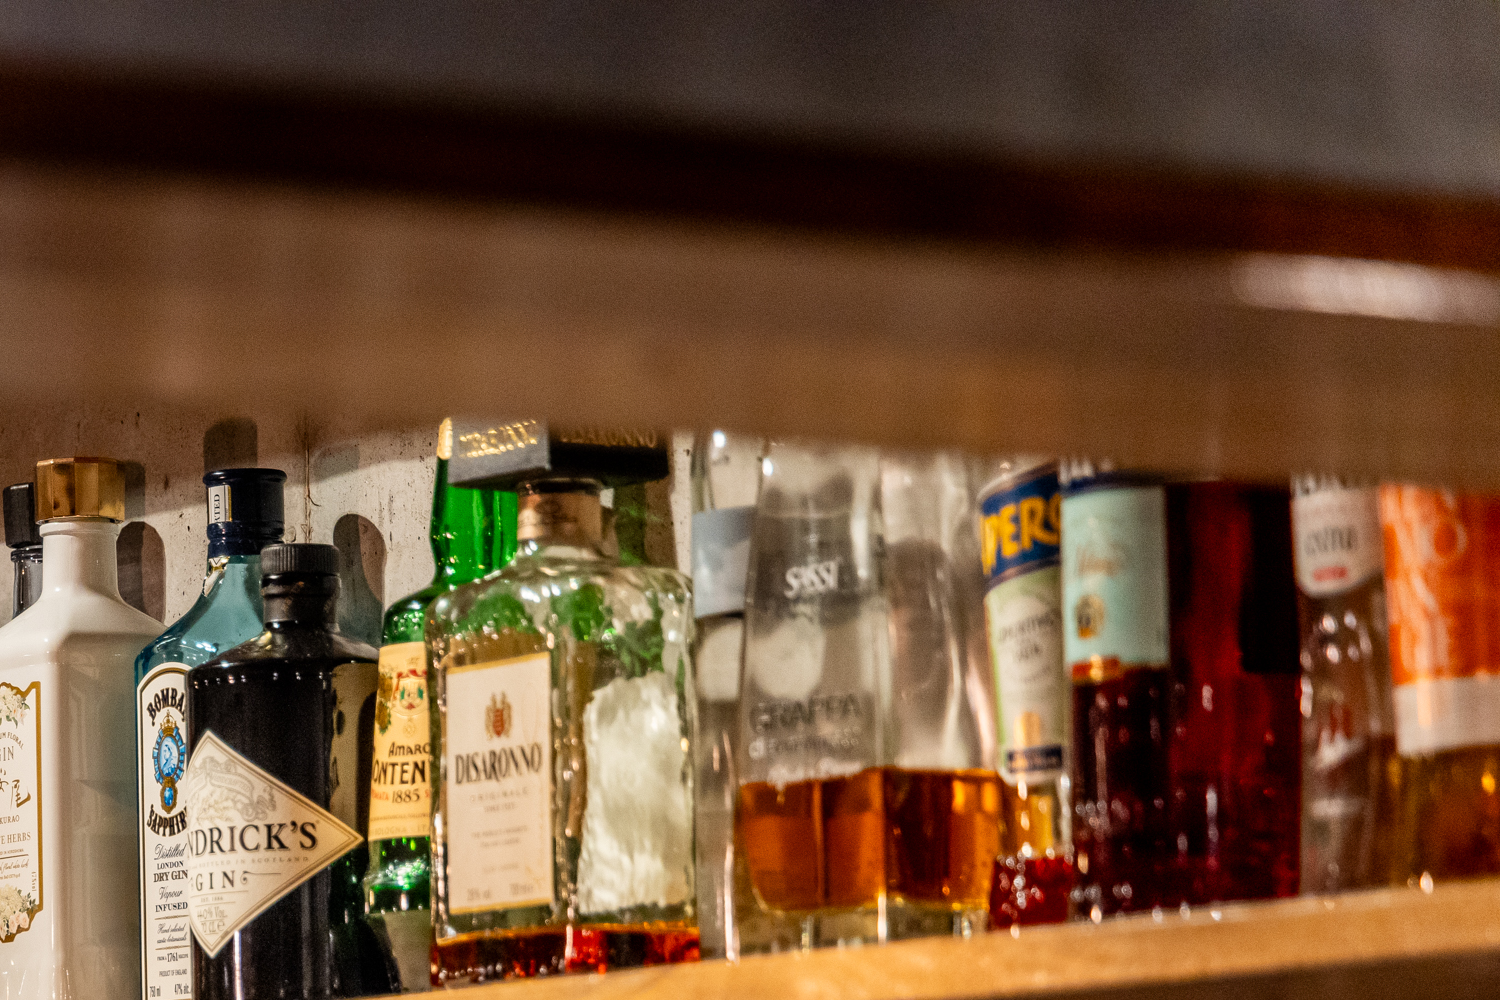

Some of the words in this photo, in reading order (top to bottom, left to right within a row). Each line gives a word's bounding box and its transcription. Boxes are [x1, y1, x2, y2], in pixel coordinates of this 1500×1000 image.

[7, 731, 24, 750] FLORAL
[455, 742, 544, 785] DISARONNO
[392, 788, 420, 804] 1885
[146, 803, 188, 837] SAPPHIR
[7, 832, 31, 844] HERBS
[153, 843, 188, 860] Distilled
[156, 860, 184, 870] LONDON
[153, 872, 170, 883] DRY
[171, 870, 188, 880] GIN
[195, 870, 235, 892] GIN
[159, 885, 183, 902] Vapour
[155, 902, 188, 912] INFUSED
[167, 952, 179, 962] 1761
[159, 970, 171, 978] PRODUCT
[175, 968, 188, 976] ENGLAND
